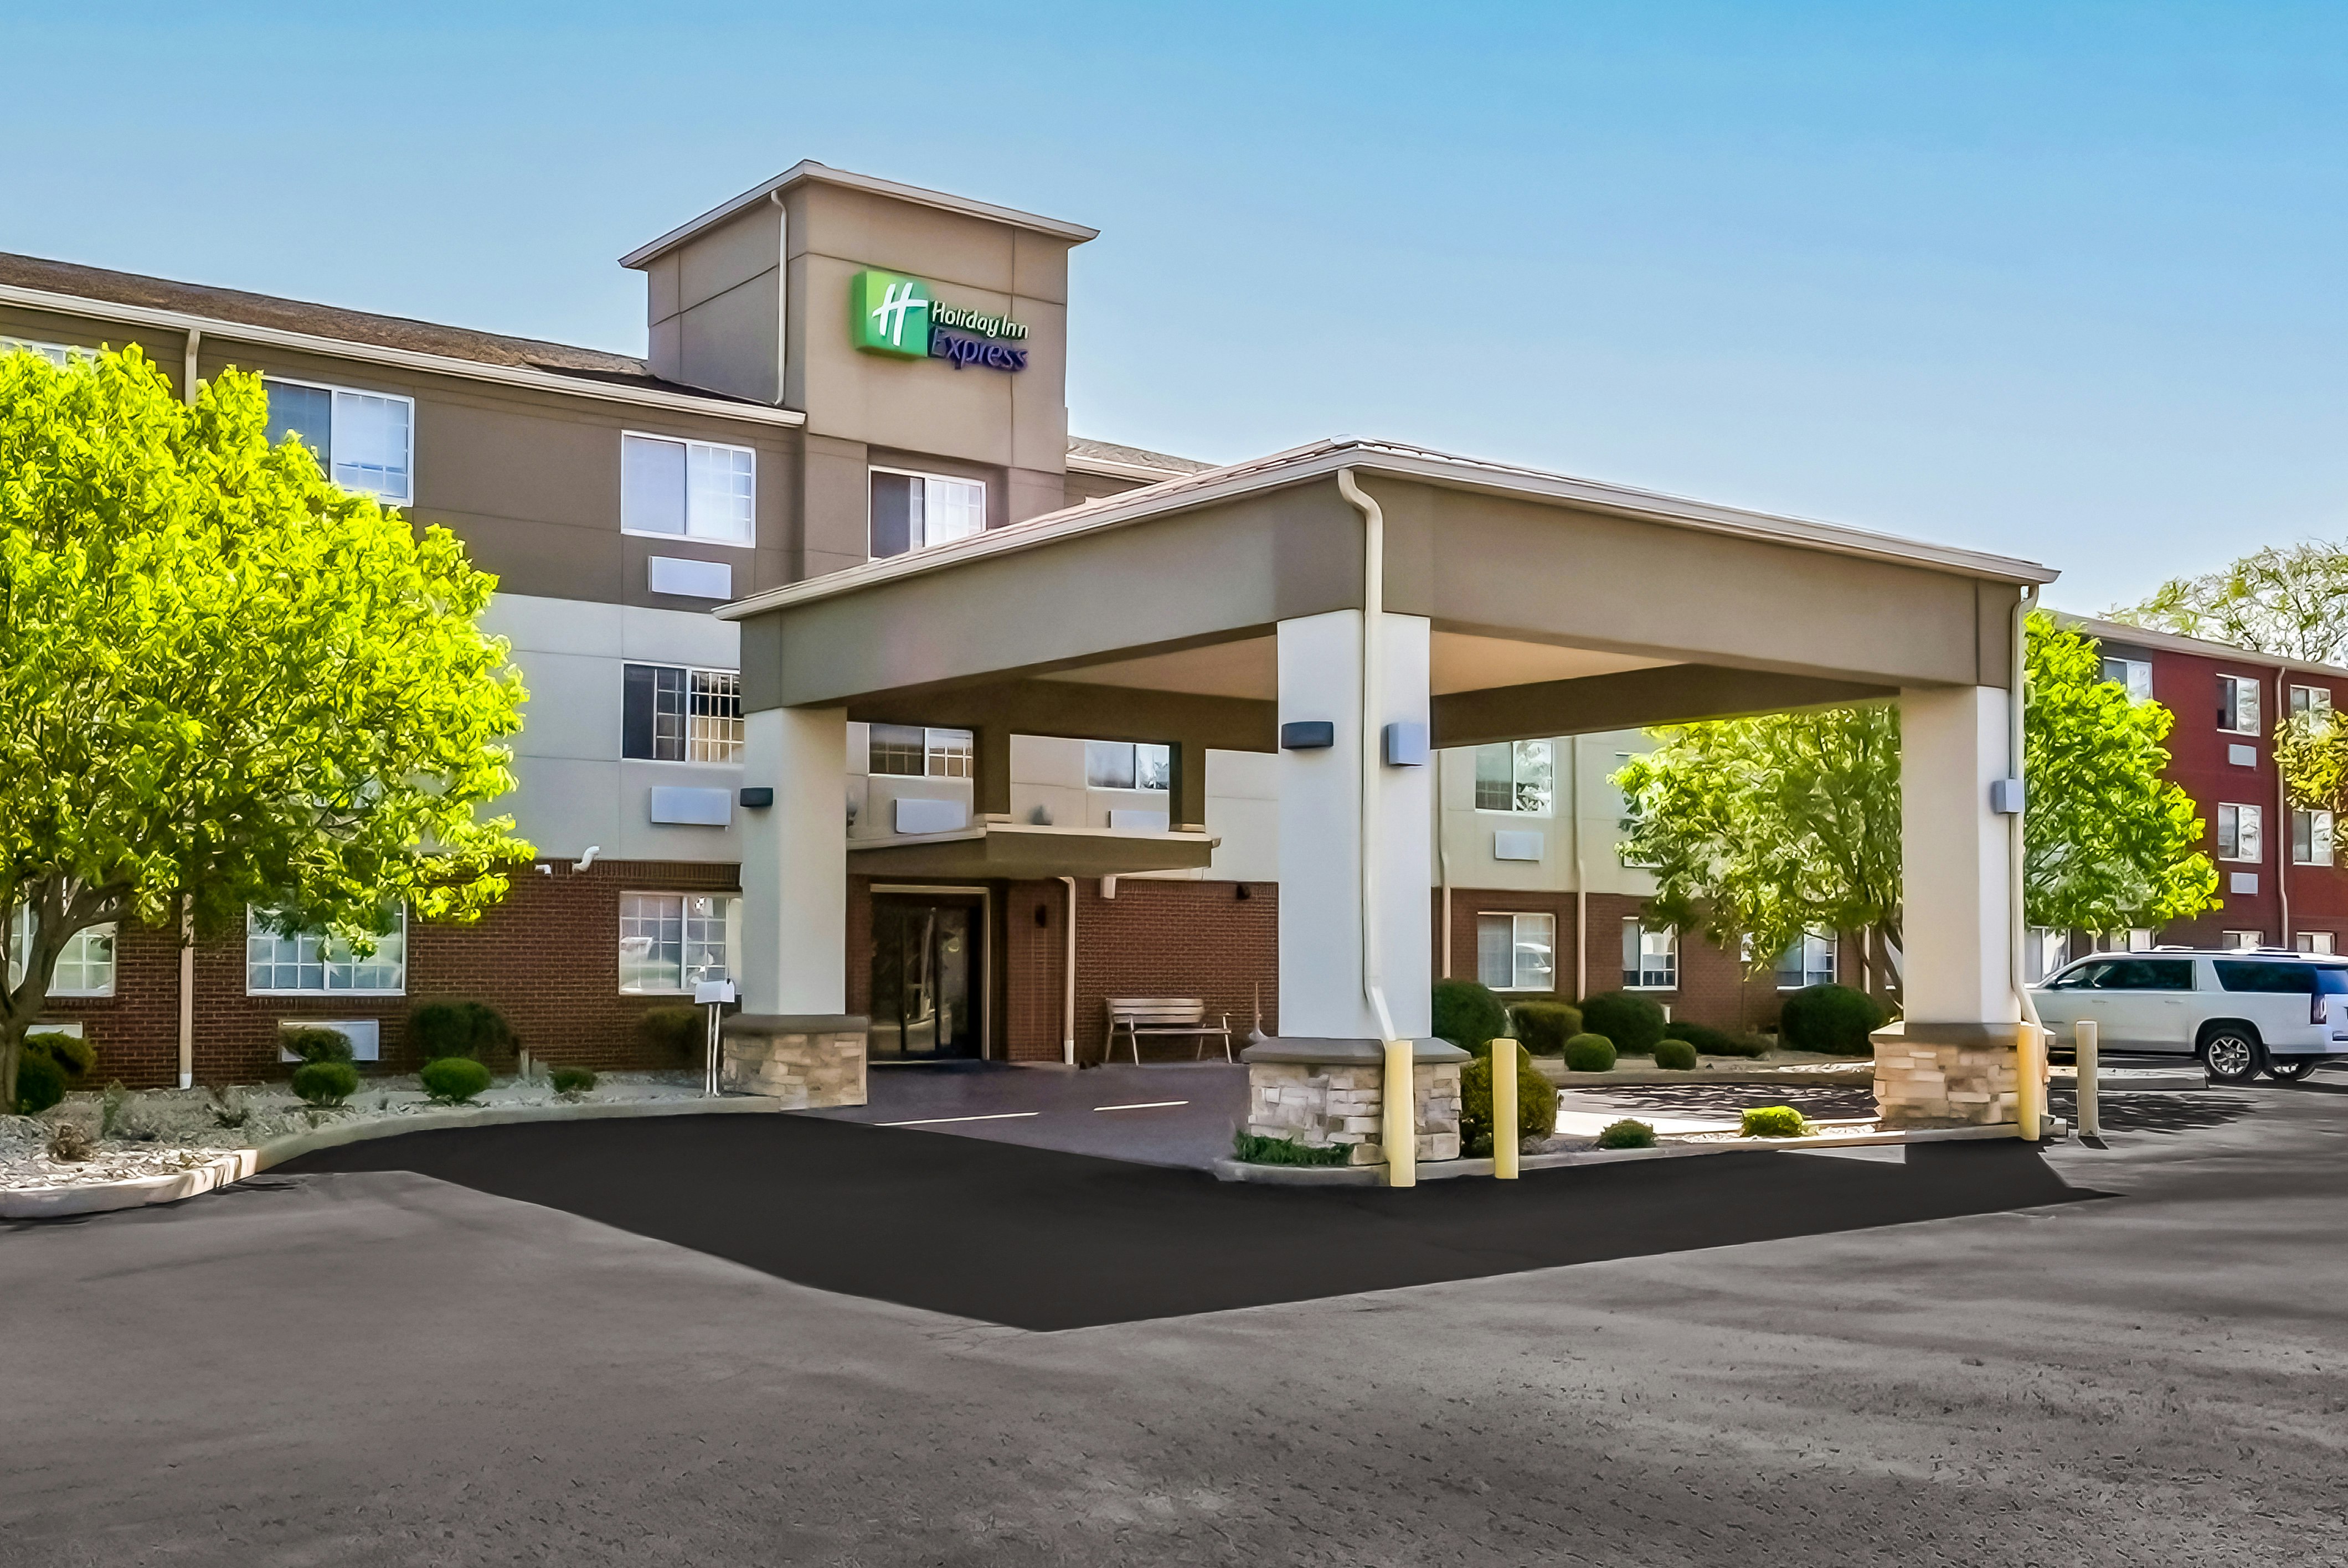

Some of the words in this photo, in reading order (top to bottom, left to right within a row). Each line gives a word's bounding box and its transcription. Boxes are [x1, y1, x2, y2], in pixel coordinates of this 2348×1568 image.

[872, 282, 928, 346] H
[932, 300, 998, 338] Holiday
[1001, 312, 1028, 339] Inn
